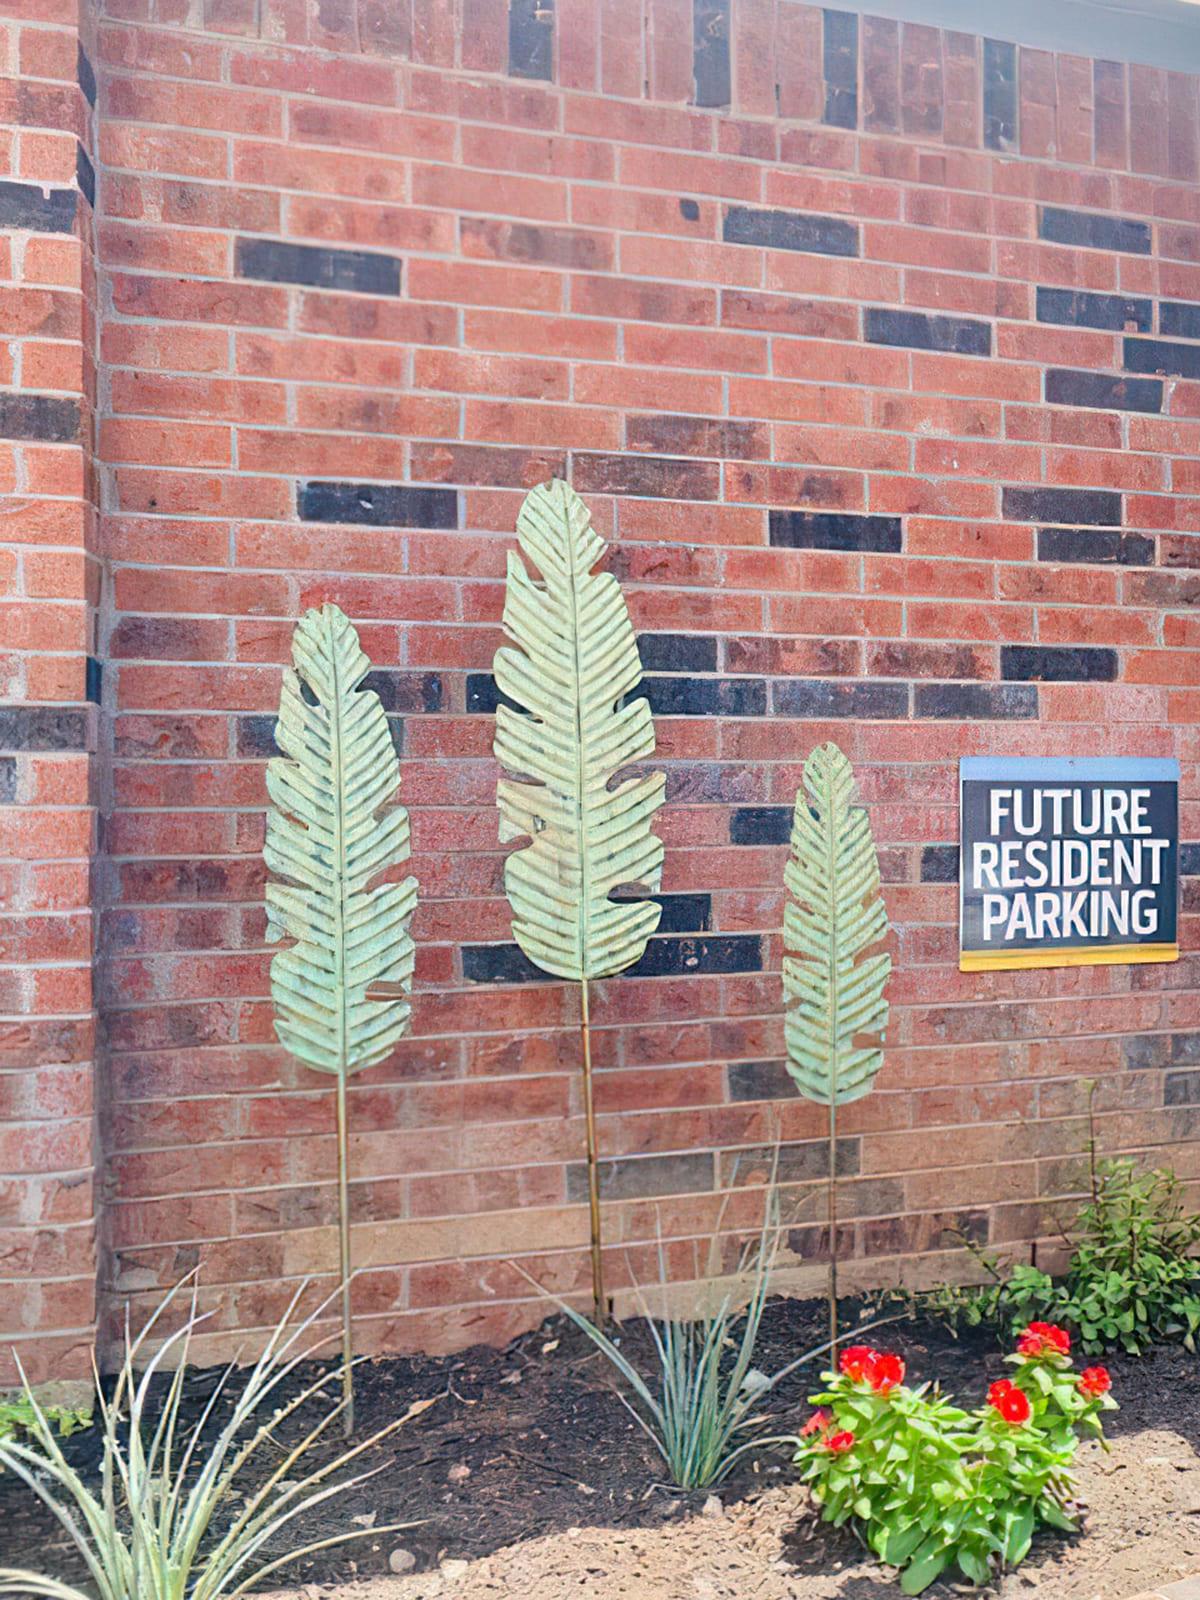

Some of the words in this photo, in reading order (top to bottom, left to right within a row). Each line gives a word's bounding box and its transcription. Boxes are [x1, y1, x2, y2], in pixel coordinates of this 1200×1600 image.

[990, 788, 1152, 836] FUTURE
[973, 839, 1170, 889] RESIDENT
[983, 890, 1158, 941] PARKING
